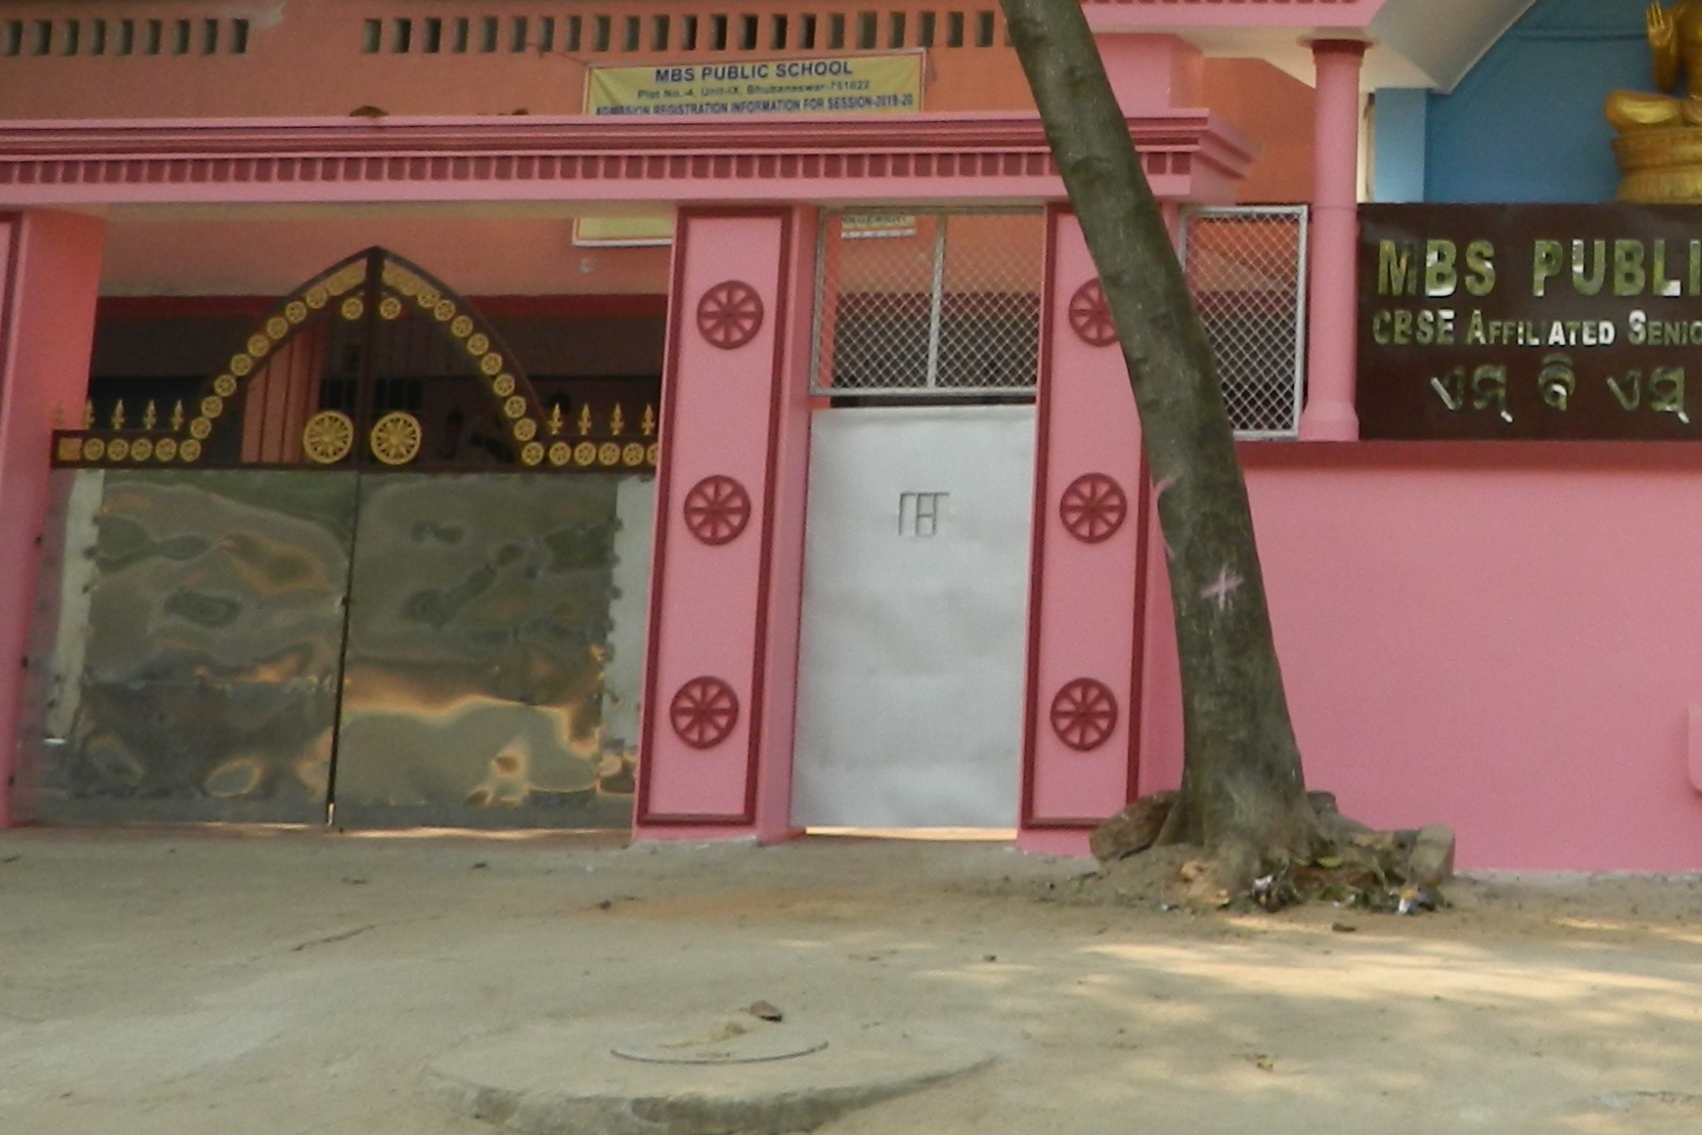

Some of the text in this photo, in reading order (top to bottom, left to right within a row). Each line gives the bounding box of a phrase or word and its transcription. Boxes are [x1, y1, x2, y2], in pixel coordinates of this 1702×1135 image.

[655, 61, 853, 82] MBS PUBLIC SCHOOL
[637, 89, 660, 99] Plot
[653, 102, 728, 115] REGISTRATION
[731, 99, 800, 113] INFORMATION
[803, 98, 825, 111] FOR
[1377, 239, 1498, 298] MBS
[1372, 309, 1455, 346] CBSE
